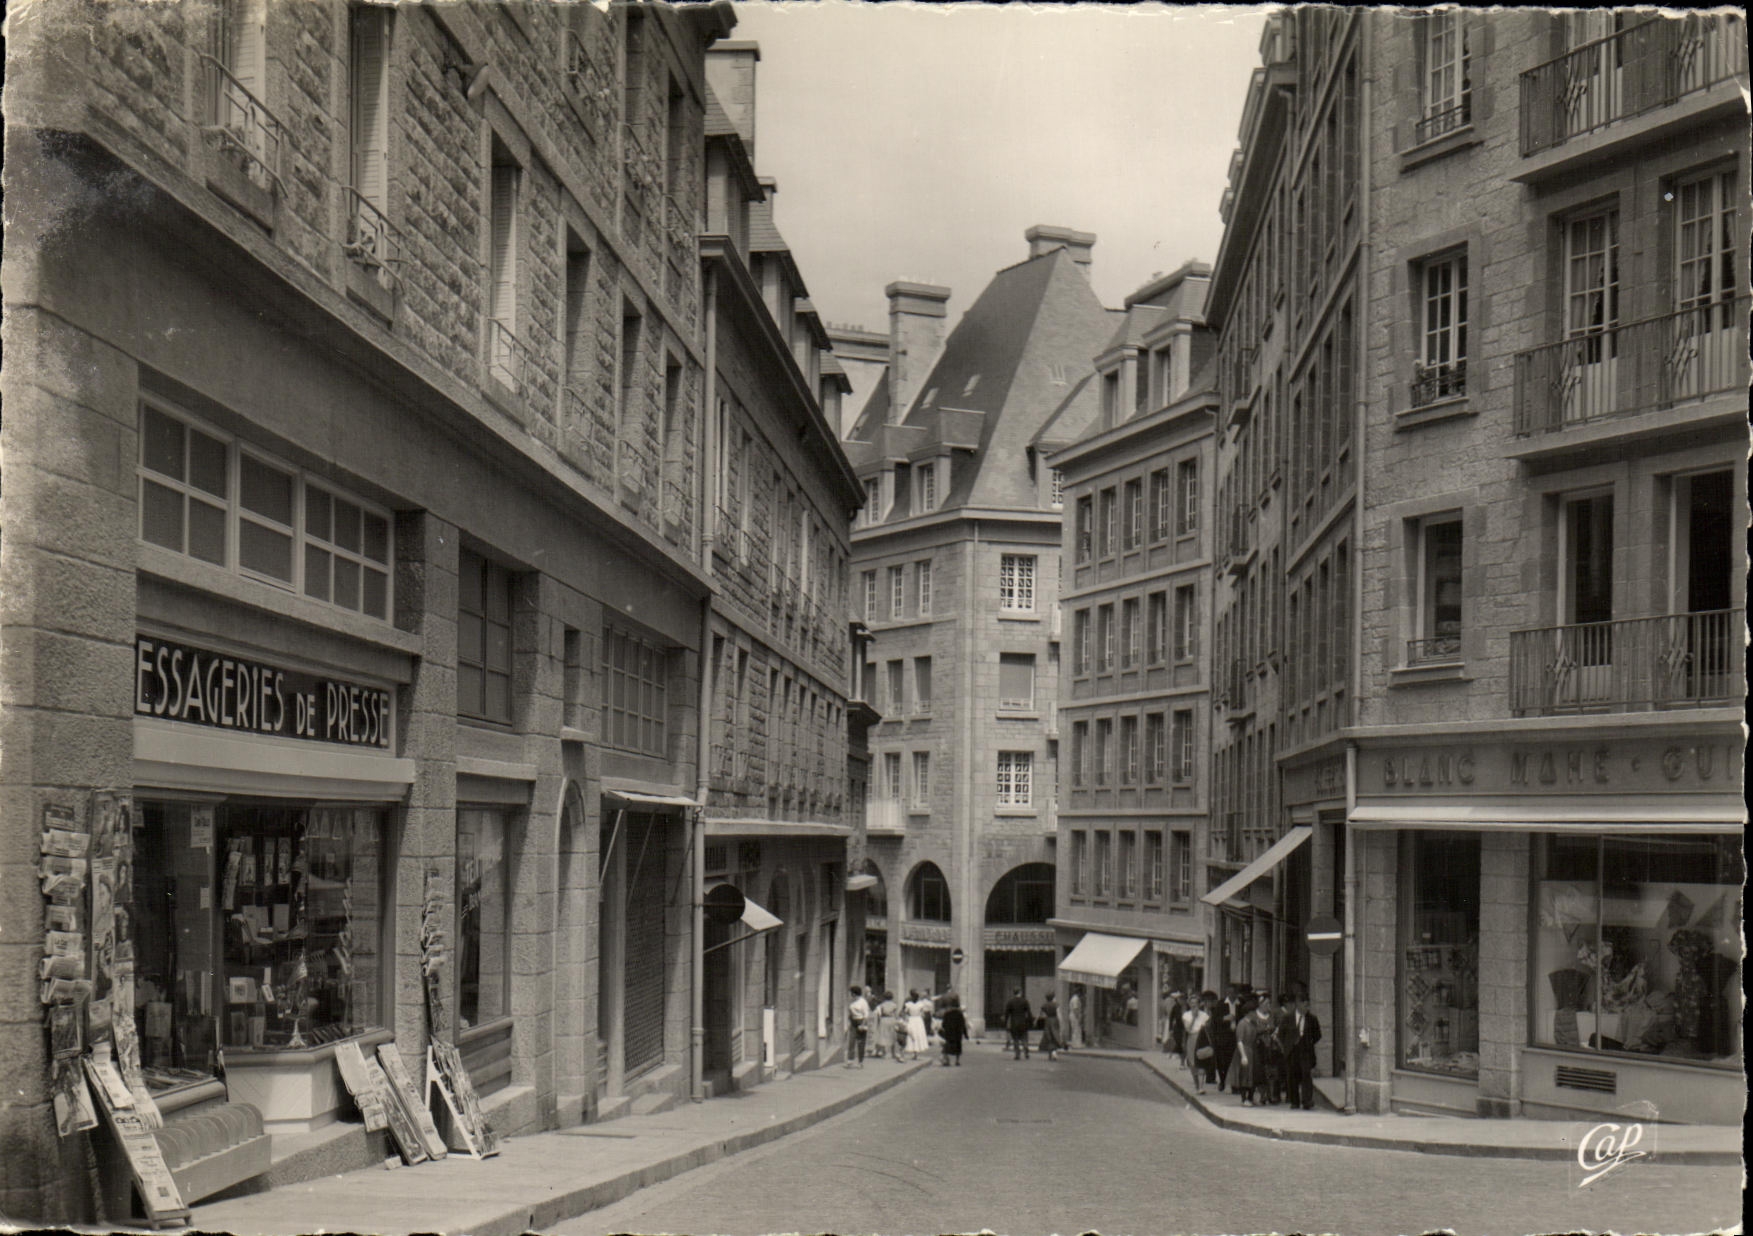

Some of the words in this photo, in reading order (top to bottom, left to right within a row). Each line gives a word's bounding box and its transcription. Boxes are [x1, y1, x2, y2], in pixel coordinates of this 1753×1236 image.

[137, 640, 284, 732] ESSAGERIES
[296, 692, 315, 737] DE
[327, 682, 389, 745] PRESSE
[1384, 753, 1475, 786] BLANC
